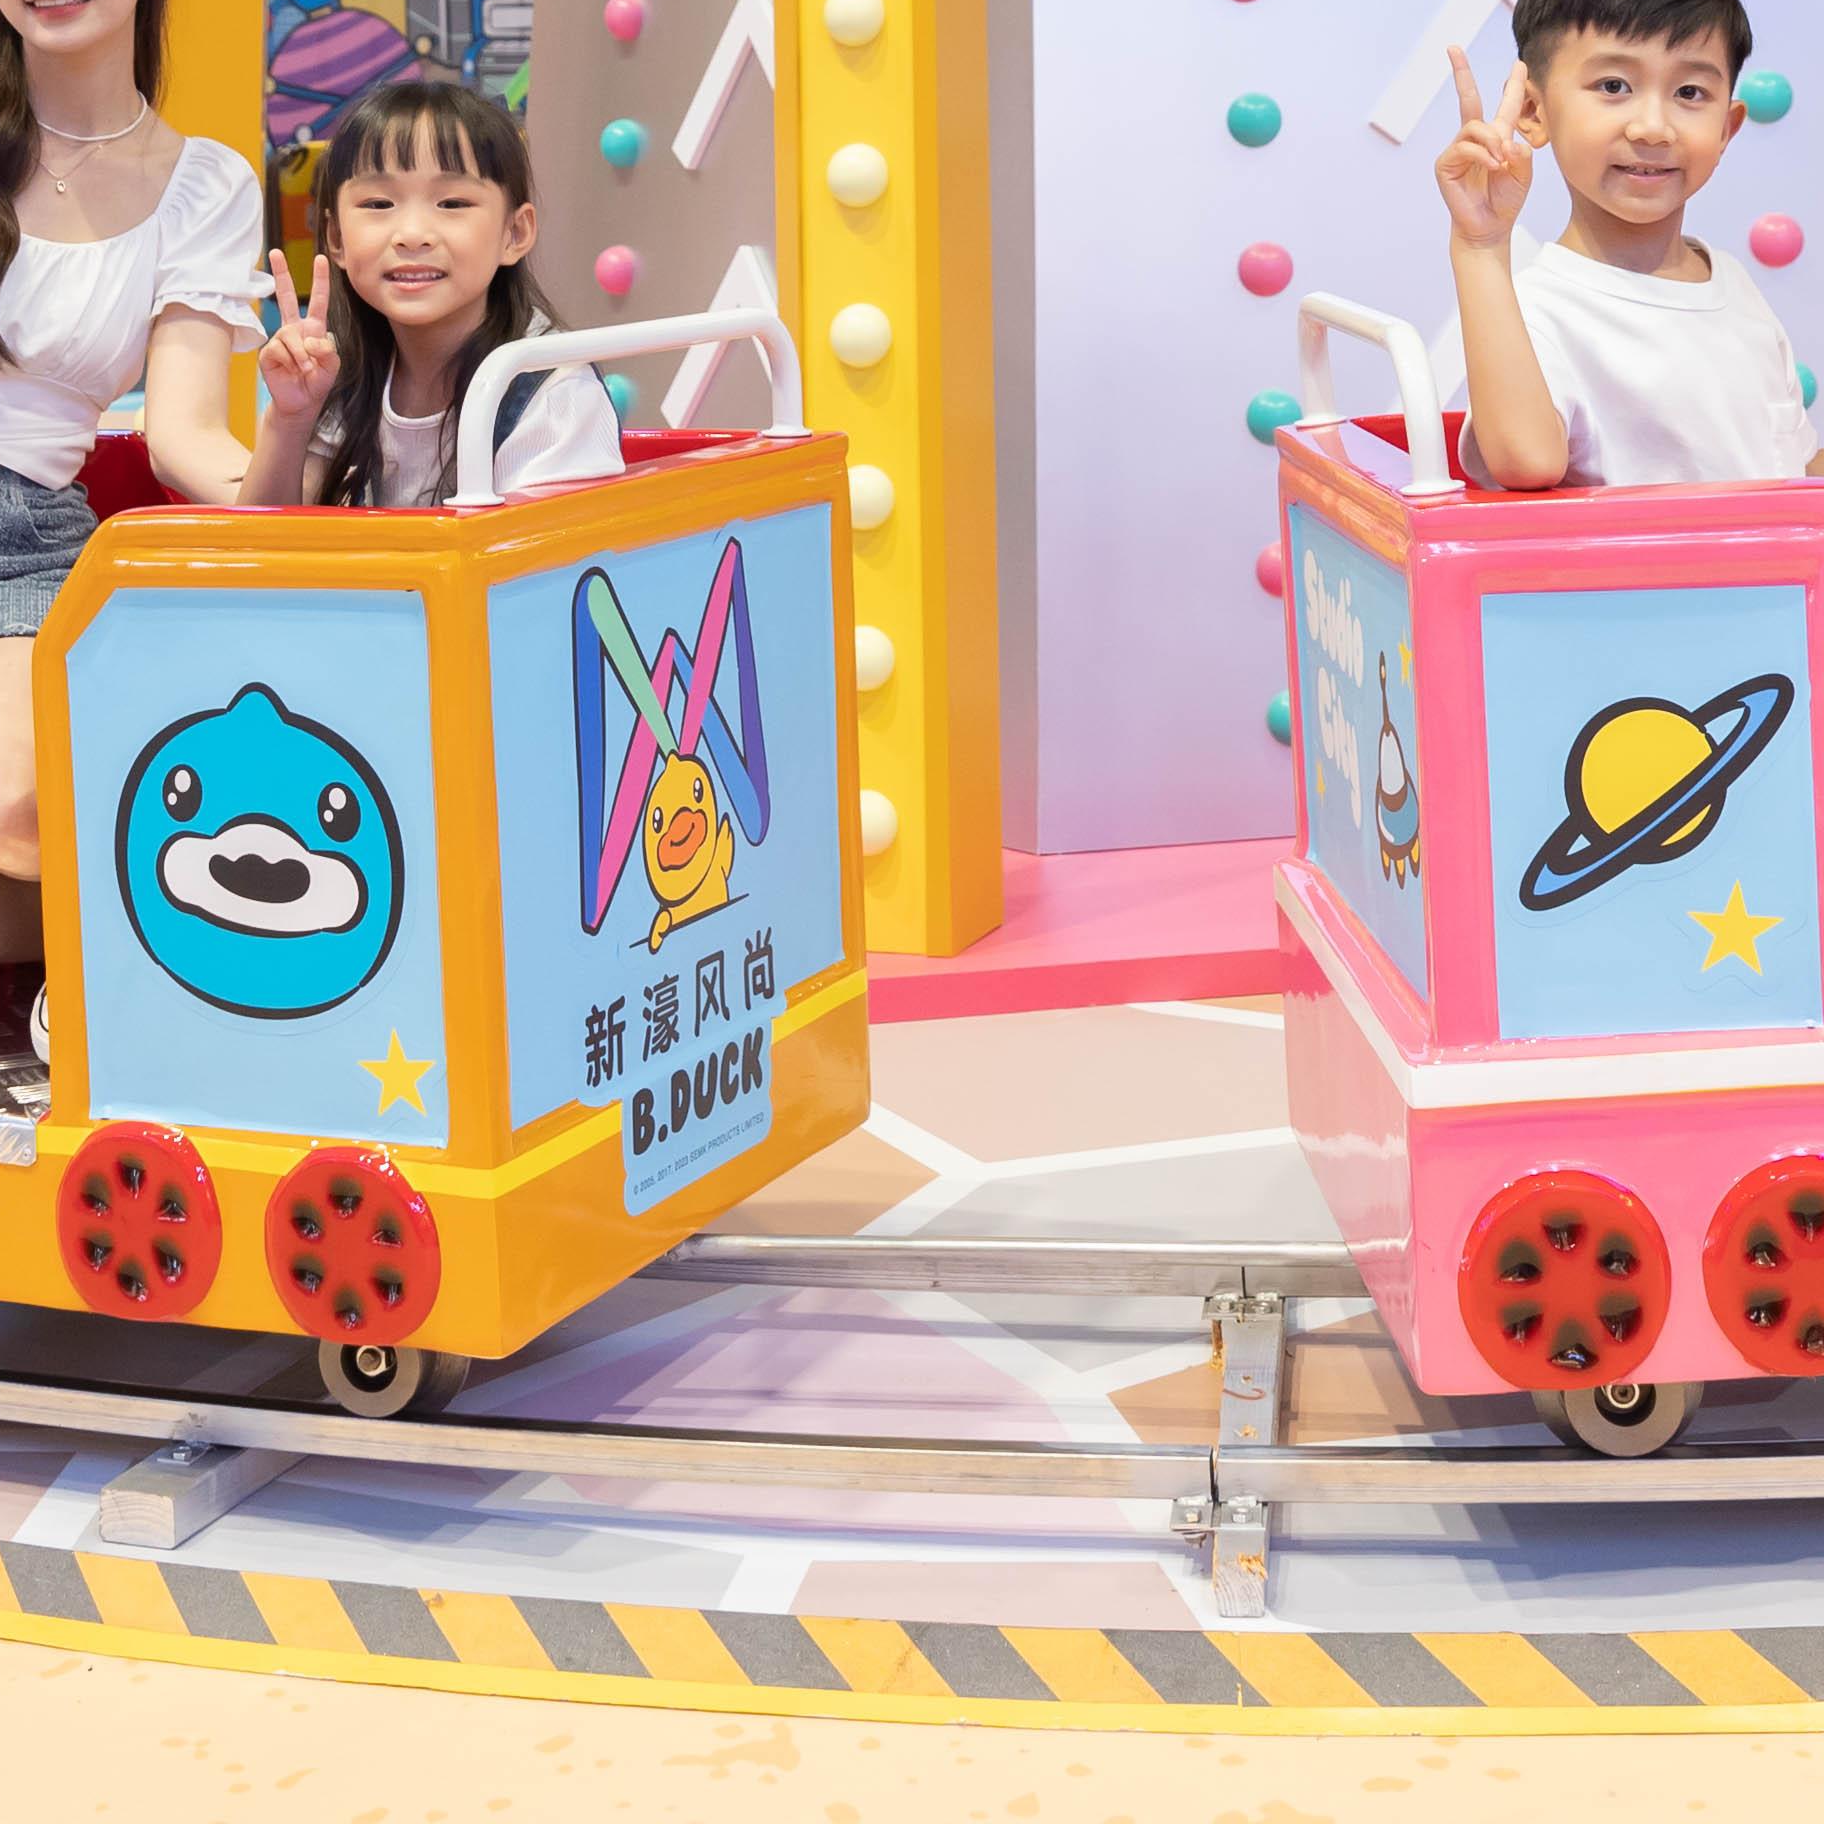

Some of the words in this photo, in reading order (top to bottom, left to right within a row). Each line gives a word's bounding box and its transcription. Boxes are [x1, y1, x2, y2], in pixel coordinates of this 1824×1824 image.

[1304, 550, 1364, 688] Studio
[1318, 666, 1361, 830] City
[585, 927, 774, 1088] 新濠风尚
[632, 1027, 764, 1156] B.DUCK
[708, 1125, 740, 1150] PRODUCTS
[741, 1112, 764, 1132] LIMITED
